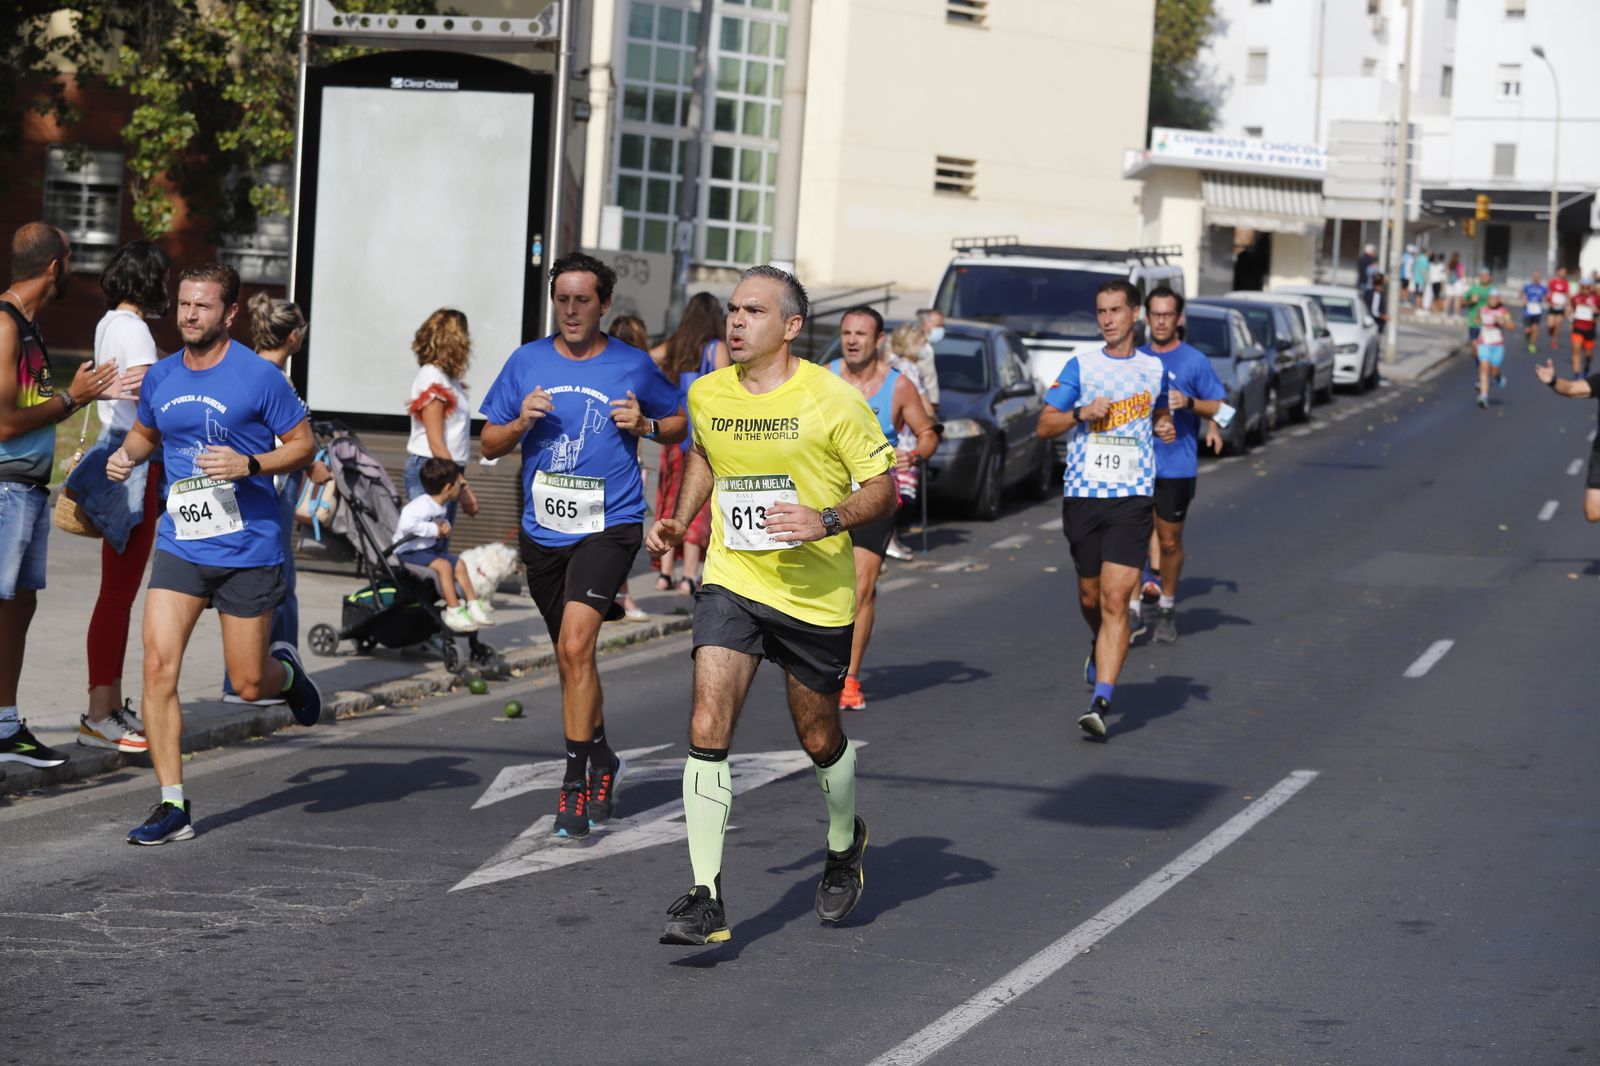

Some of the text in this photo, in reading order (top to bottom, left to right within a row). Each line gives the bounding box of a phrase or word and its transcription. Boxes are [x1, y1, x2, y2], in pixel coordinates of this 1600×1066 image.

[403, 78, 459, 90] Clear Channel
[1194, 147, 1322, 168] PATATAS FRITAS
[711, 416, 799, 432] TOP RUNNERS
[733, 431, 799, 441] IN THE WORLD
[1094, 453, 1120, 470] 419
[547, 476, 569, 488] VUELTA
[575, 479, 599, 490] HUELVA
[729, 479, 754, 490] VUELTA
[755, 479, 761, 489] A
[762, 478, 791, 490] HUELVA
[179, 501, 213, 523] 664
[545, 497, 578, 519] 665
[732, 506, 768, 531] 613
